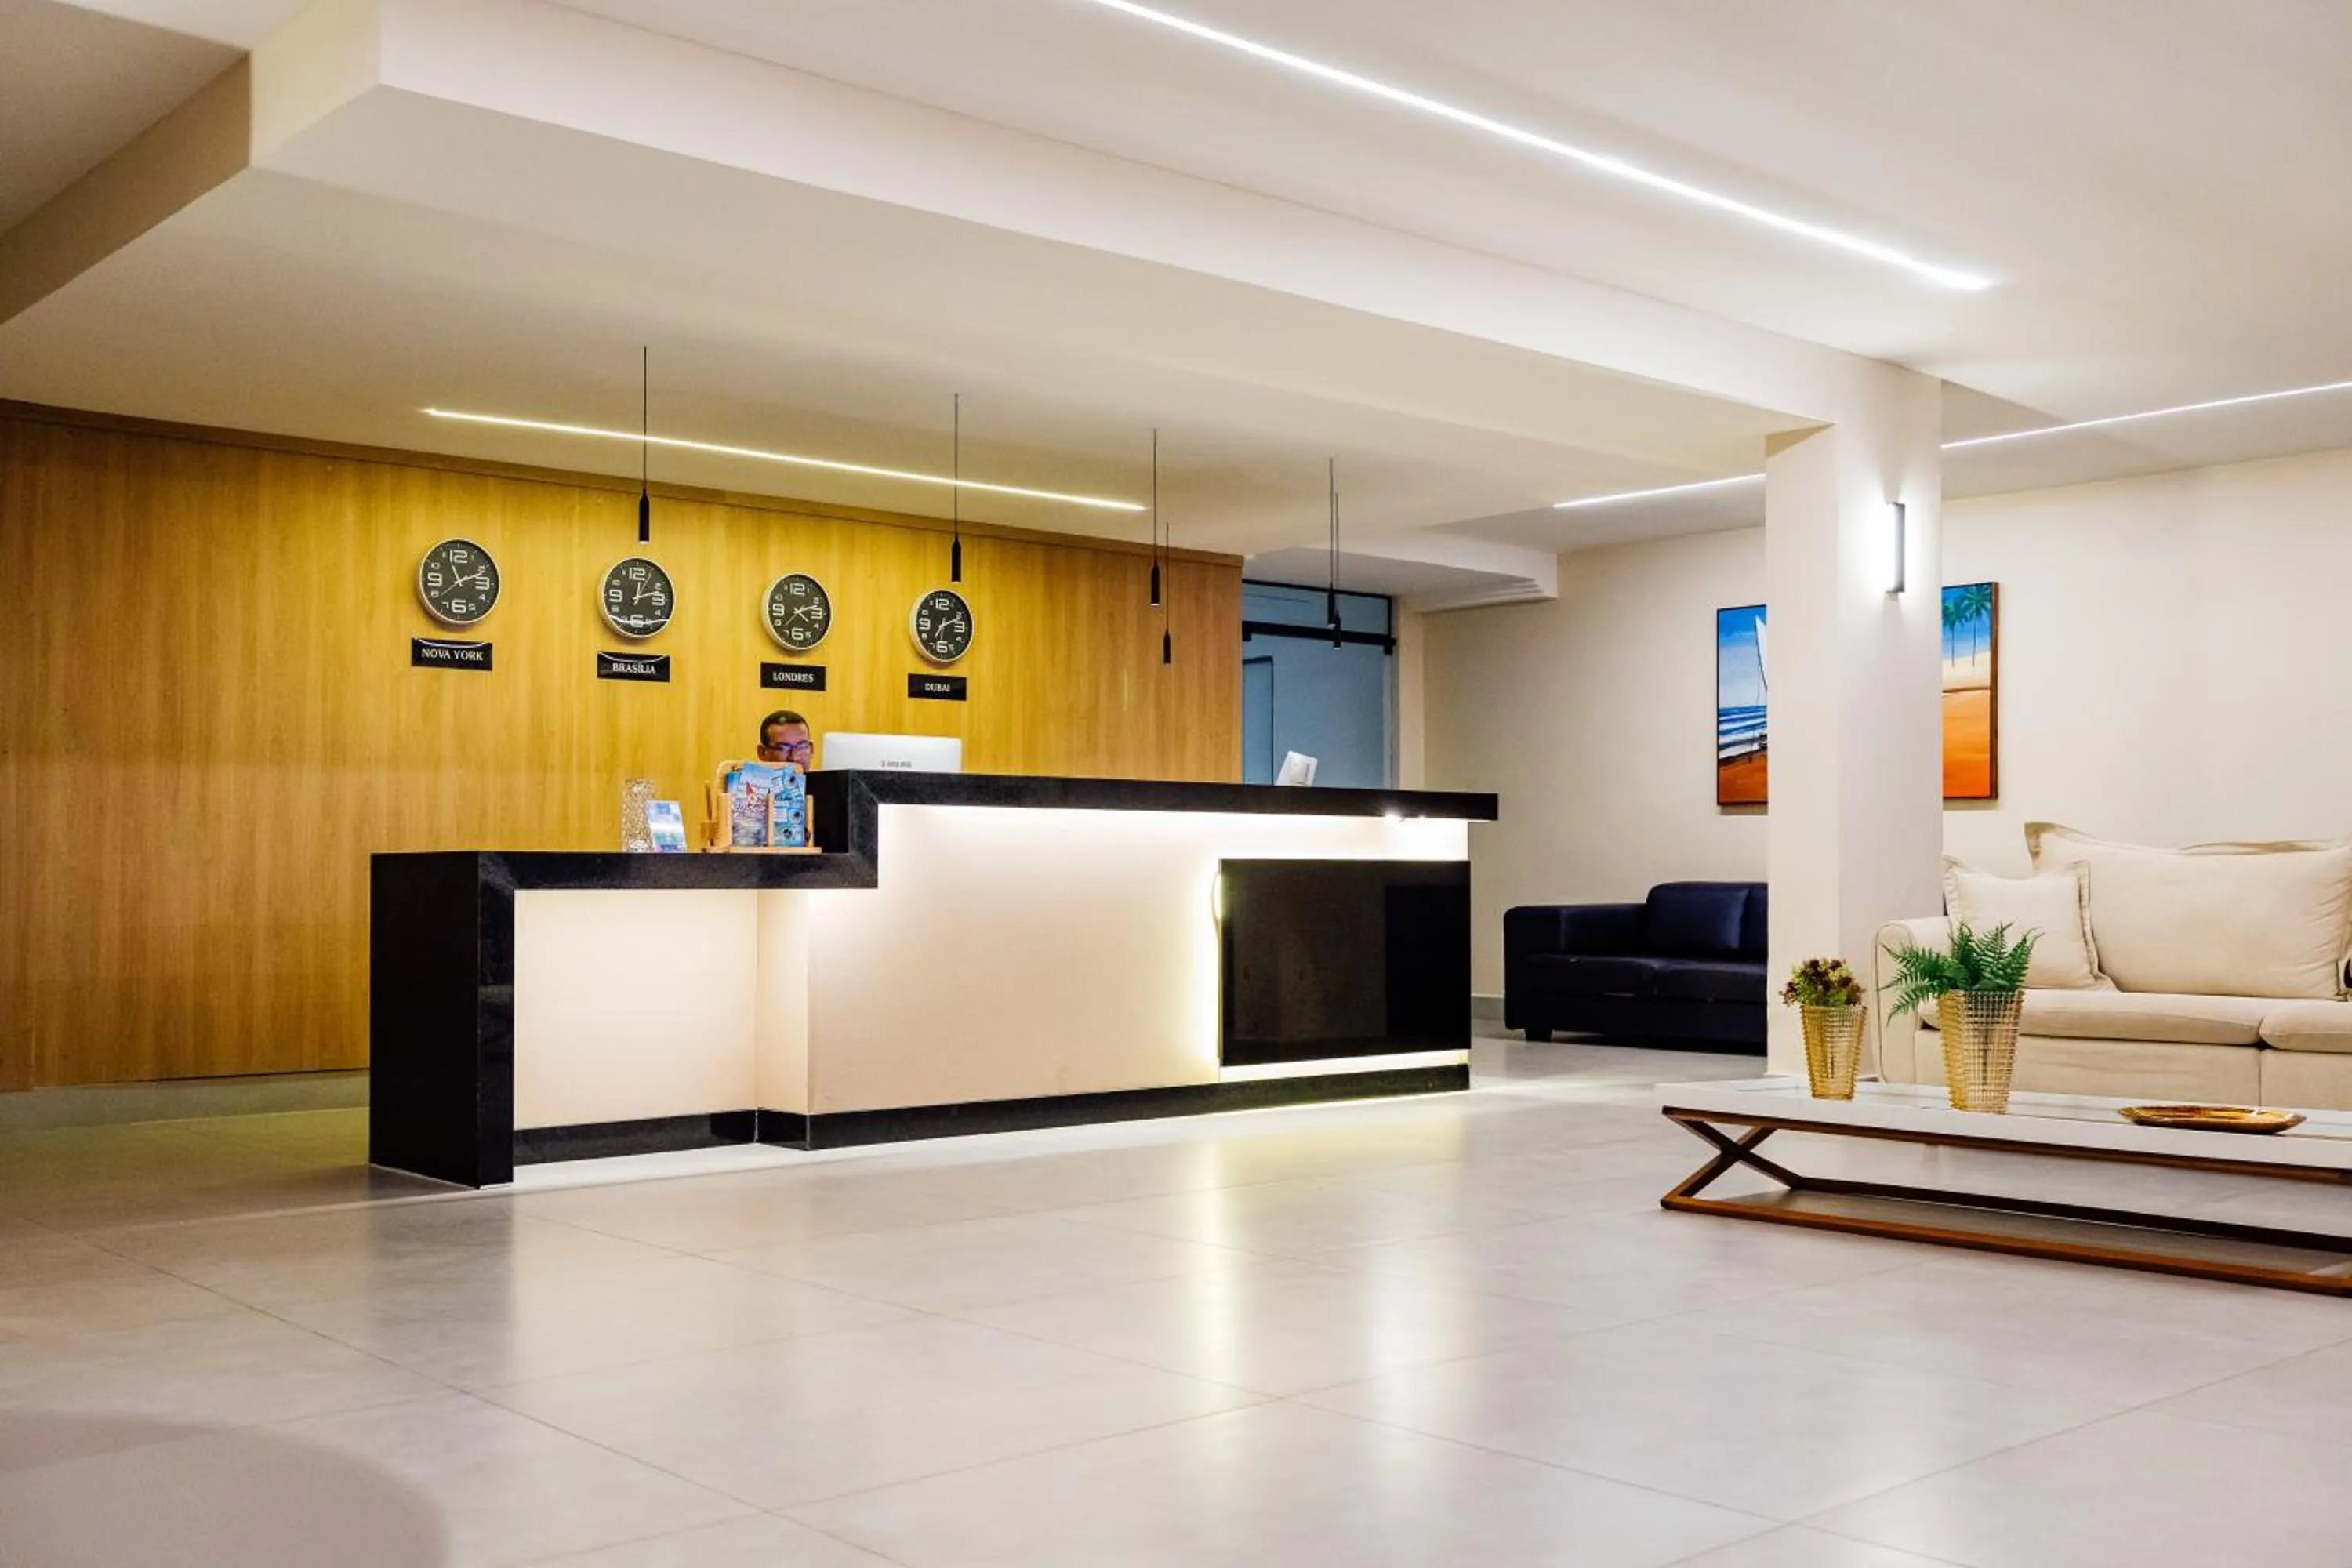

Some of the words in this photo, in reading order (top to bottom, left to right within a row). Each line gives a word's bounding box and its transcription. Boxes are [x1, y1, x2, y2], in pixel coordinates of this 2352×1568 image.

[450, 550, 468, 564] 12
[427, 572, 442, 587] 9
[629, 568, 645, 581] 12
[475, 576, 490, 590] 3
[790, 583, 804, 596] 12
[609, 589, 622, 603] 9
[652, 593, 665, 606] 3
[451, 599, 466, 614] 6
[773, 603, 784, 615] 9
[936, 598, 949, 611] 12
[811, 608, 822, 619] 3
[919, 618, 931, 630] 9
[954, 621, 965, 633] 3
[791, 627, 804, 640] 6
[937, 641, 948, 653] 6
[422, 648, 451, 659] NOVA
[453, 650, 484, 661] YORK
[773, 671, 814, 683] LONDRES
[925, 683, 951, 692] DUBAI
